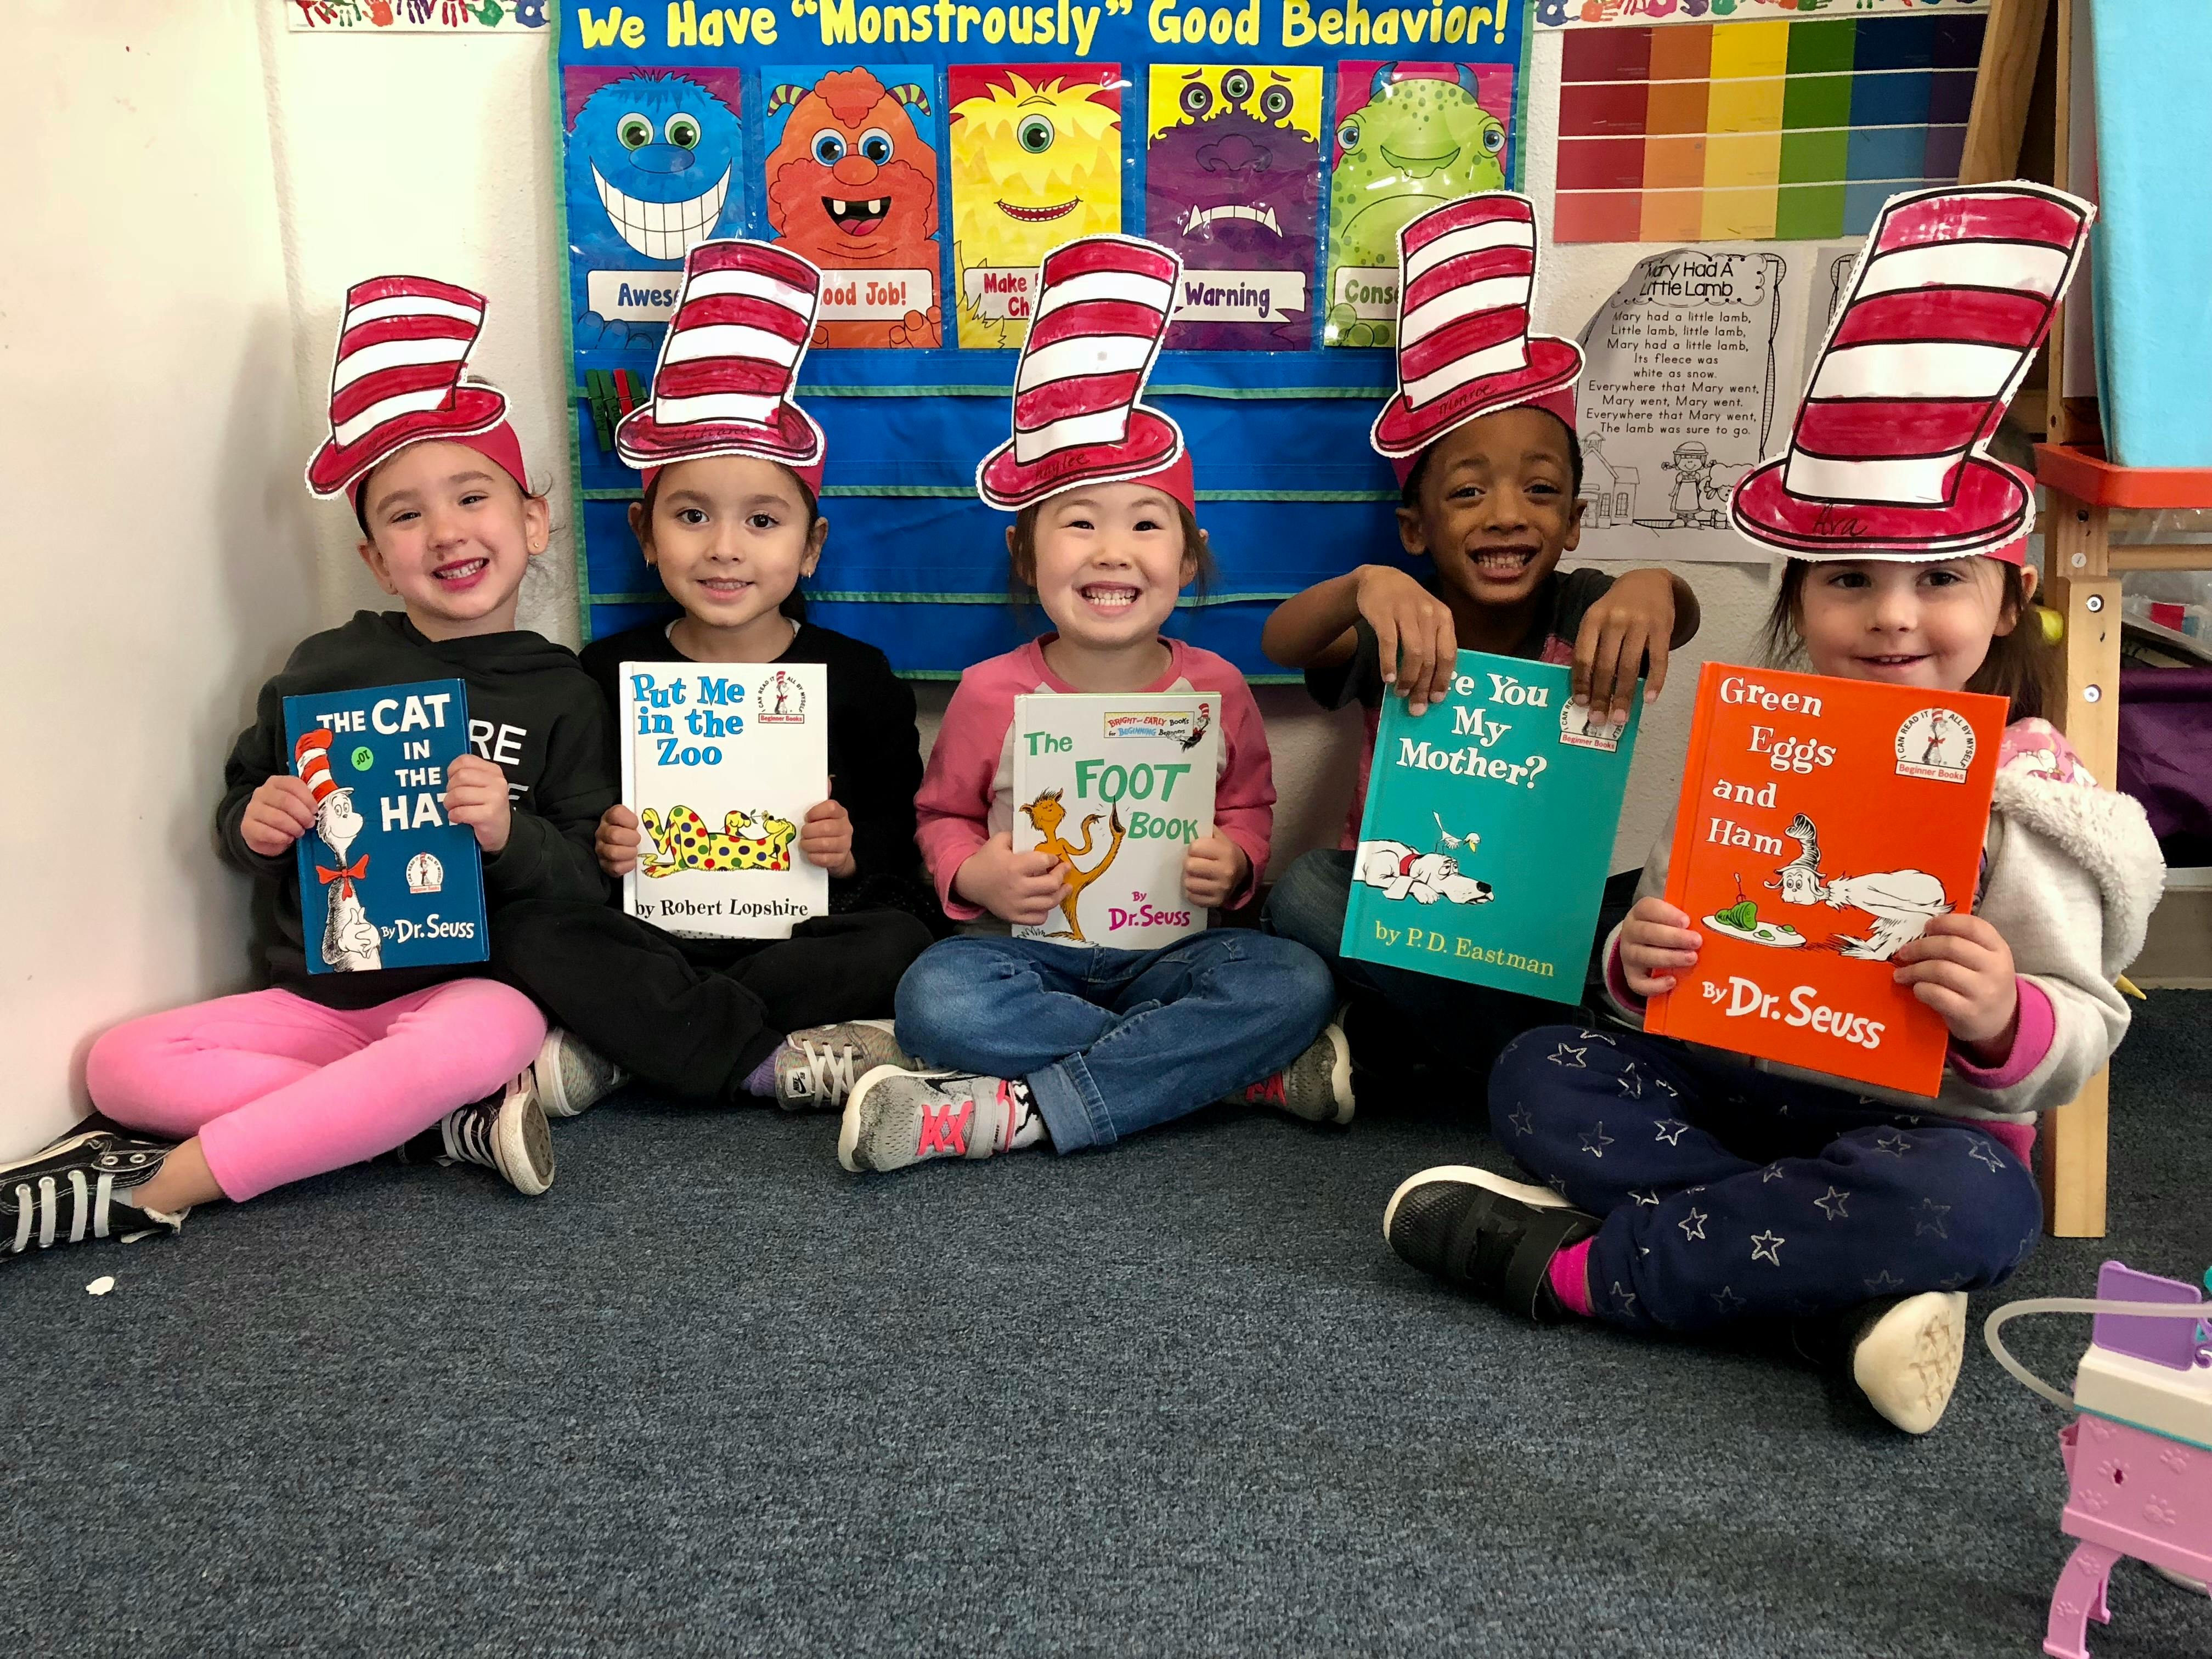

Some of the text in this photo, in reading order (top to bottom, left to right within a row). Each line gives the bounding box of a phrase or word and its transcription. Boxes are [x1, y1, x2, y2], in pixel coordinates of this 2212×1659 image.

[579, 8, 645, 49] We
[667, 2, 777, 47] Have
[1148, 3, 1260, 46] Good
[1282, 0, 1506, 48] Behavior!
[1684, 262, 1717, 277] Had
[1720, 262, 1733, 277] A
[820, 281, 906, 306] ood Job!
[984, 273, 1027, 294] Make
[1685, 281, 1733, 296] Lamb
[1185, 281, 1271, 317] Warning
[1613, 311, 1640, 323] Mary
[1647, 311, 1669, 321] had
[1689, 312, 1713, 322] little
[1720, 312, 1751, 324] lamb,
[1611, 325, 1746, 337] Little lamb, little lamb,
[1607, 338, 1639, 351] Mary
[1645, 339, 1667, 349] had
[1686, 340, 1712, 350] little
[1718, 340, 1749, 352] lamb,
[1635, 353, 1648, 363] Its
[1655, 353, 1692, 364] fleece
[1634, 368, 1663, 377] white
[1589, 380, 1759, 394] Everywhere that Mary went,
[1602, 394, 1743, 408] Mary went, Mary went.
[1587, 408, 1756, 422] Everywhere that Mary went,
[1601, 422, 1620, 433] The
[1626, 423, 1654, 433] lamb
[1717, 426, 1727, 434] to
[1734, 427, 1751, 438] go.
[1812, 501, 1868, 536] Ava
[630, 674, 745, 708] Put Me
[1487, 673, 1549, 707] You
[1720, 676, 1822, 717] Green
[316, 693, 450, 735] THE CAT
[637, 707, 743, 737] in the
[1108, 716, 1137, 727] BRIGHT
[1144, 716, 1167, 726] EARLY
[1900, 716, 1919, 734] READ
[1948, 714, 1962, 726] ALL
[1118, 727, 1156, 736] BEGINNING
[1451, 706, 1513, 747] My
[1961, 725, 1972, 735] BY
[403, 739, 431, 761] IN
[657, 738, 722, 766] Zoo
[1024, 731, 1073, 755] The
[1562, 735, 1615, 749] Beginner Books
[1747, 725, 1837, 775] Eggs
[1960, 738, 1974, 768] MYSELF
[1396, 737, 1548, 789] Mother?
[1899, 764, 1963, 780] Beginner Books
[394, 766, 441, 788] THE
[1075, 759, 1192, 803] FOOT
[1712, 780, 1777, 809] and
[1128, 811, 1199, 844] BOOK
[1705, 816, 1783, 856] Ham
[1132, 891, 1147, 902] By
[635, 898, 808, 919] by Robert Lopshire
[1108, 905, 1190, 930] Dr. Seuss
[381, 914, 475, 944] By Dr. Seuss
[1375, 920, 1401, 946] by
[1455, 936, 1554, 977] Eastman
[1702, 974, 1886, 1051] By Dr. Seuss
